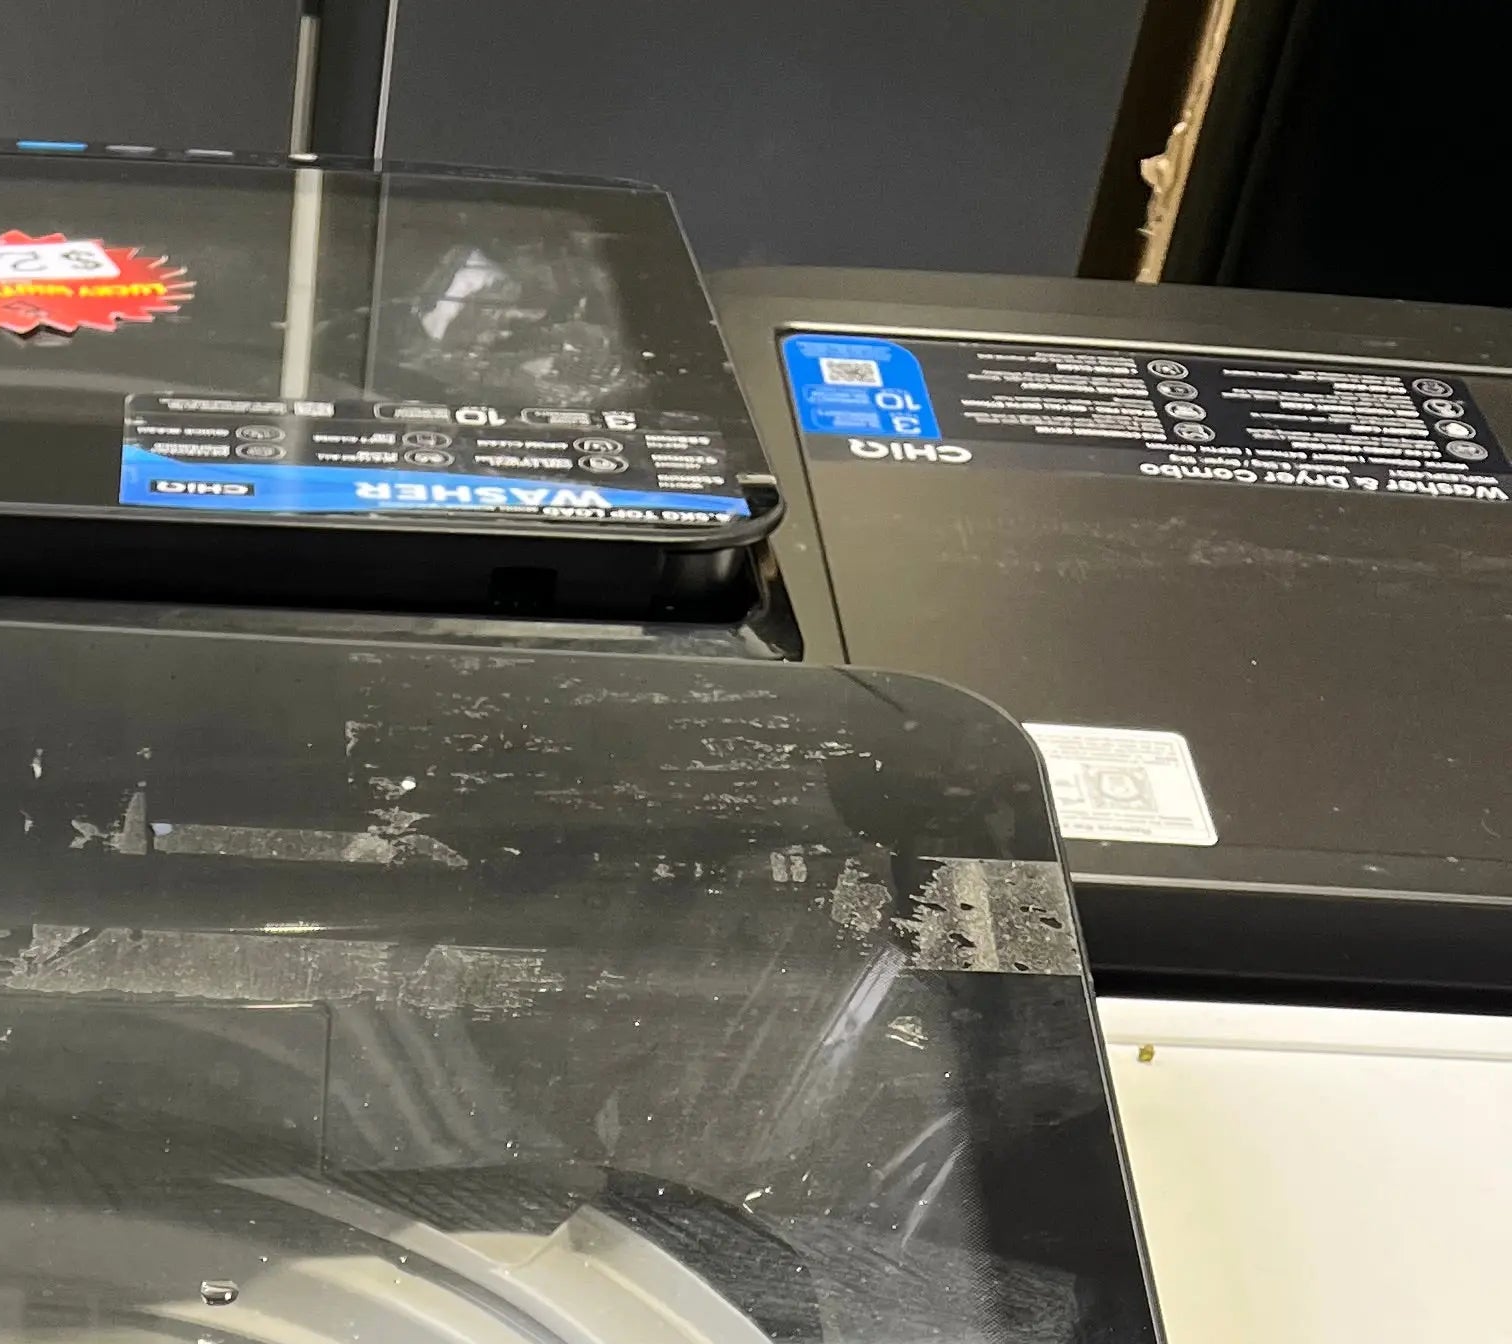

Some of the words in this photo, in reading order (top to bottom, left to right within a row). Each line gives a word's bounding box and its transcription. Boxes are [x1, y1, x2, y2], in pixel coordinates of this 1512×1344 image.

[874, 391, 922, 410] 10
[456, 409, 507, 427] 10
[602, 414, 638, 431] 3
[891, 415, 923, 434] 3
[1140, 463, 1258, 483] Combo
[1263, 469, 1349, 490] Dryer
[1353, 475, 1379, 491] &
[1386, 477, 1510, 501] Washer
[354, 481, 612, 508] WASHER
